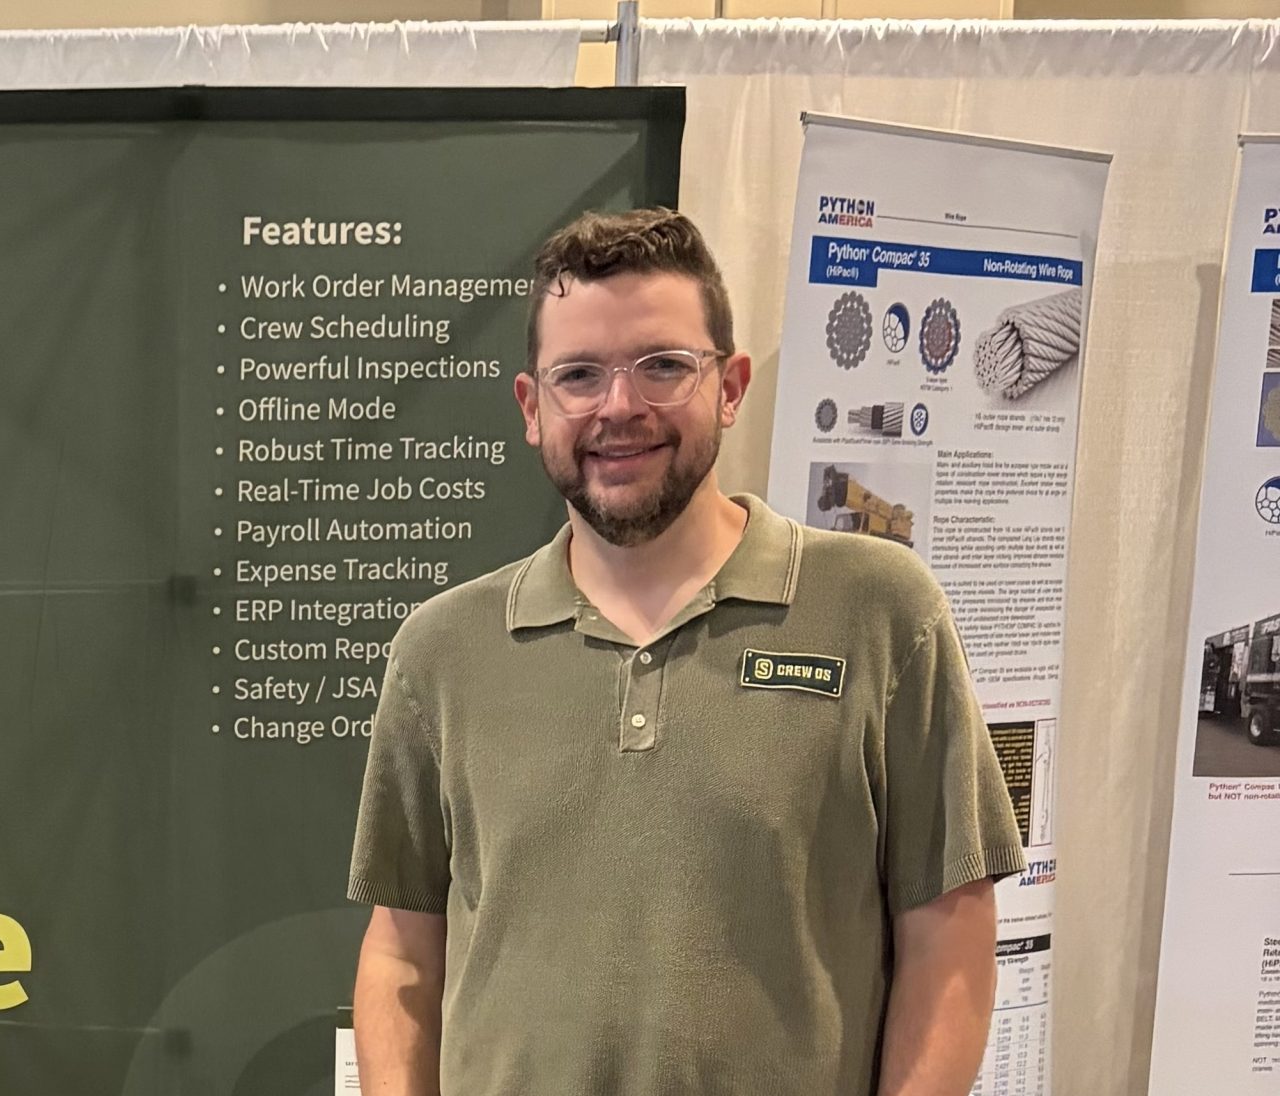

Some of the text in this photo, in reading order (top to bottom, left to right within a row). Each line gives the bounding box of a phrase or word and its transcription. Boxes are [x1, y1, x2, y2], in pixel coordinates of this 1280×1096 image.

[819, 196, 875, 216] PYTHON
[243, 217, 402, 245] Features:
[818, 212, 873, 228] AMERICA
[918, 252, 930, 267] 35
[983, 259, 1073, 280] Non-Rotating Wire Rope
[241, 274, 305, 298] Work
[312, 273, 384, 297] Order
[240, 314, 450, 343] Crew Scheduling
[240, 355, 500, 384] Powerful Inspections
[239, 396, 396, 421] Offline Mode
[239, 436, 506, 464] Robust Time Tracking
[238, 477, 486, 501] Real-Time Job Costs
[237, 517, 472, 547] Payroll Automation
[237, 557, 448, 587] Expense Tracking
[236, 600, 283, 621] ERP
[235, 639, 326, 661] Custom
[777, 664, 832, 682] CREW OS
[234, 677, 309, 704] Safety
[332, 677, 377, 698] JSA
[234, 717, 324, 744] Change
